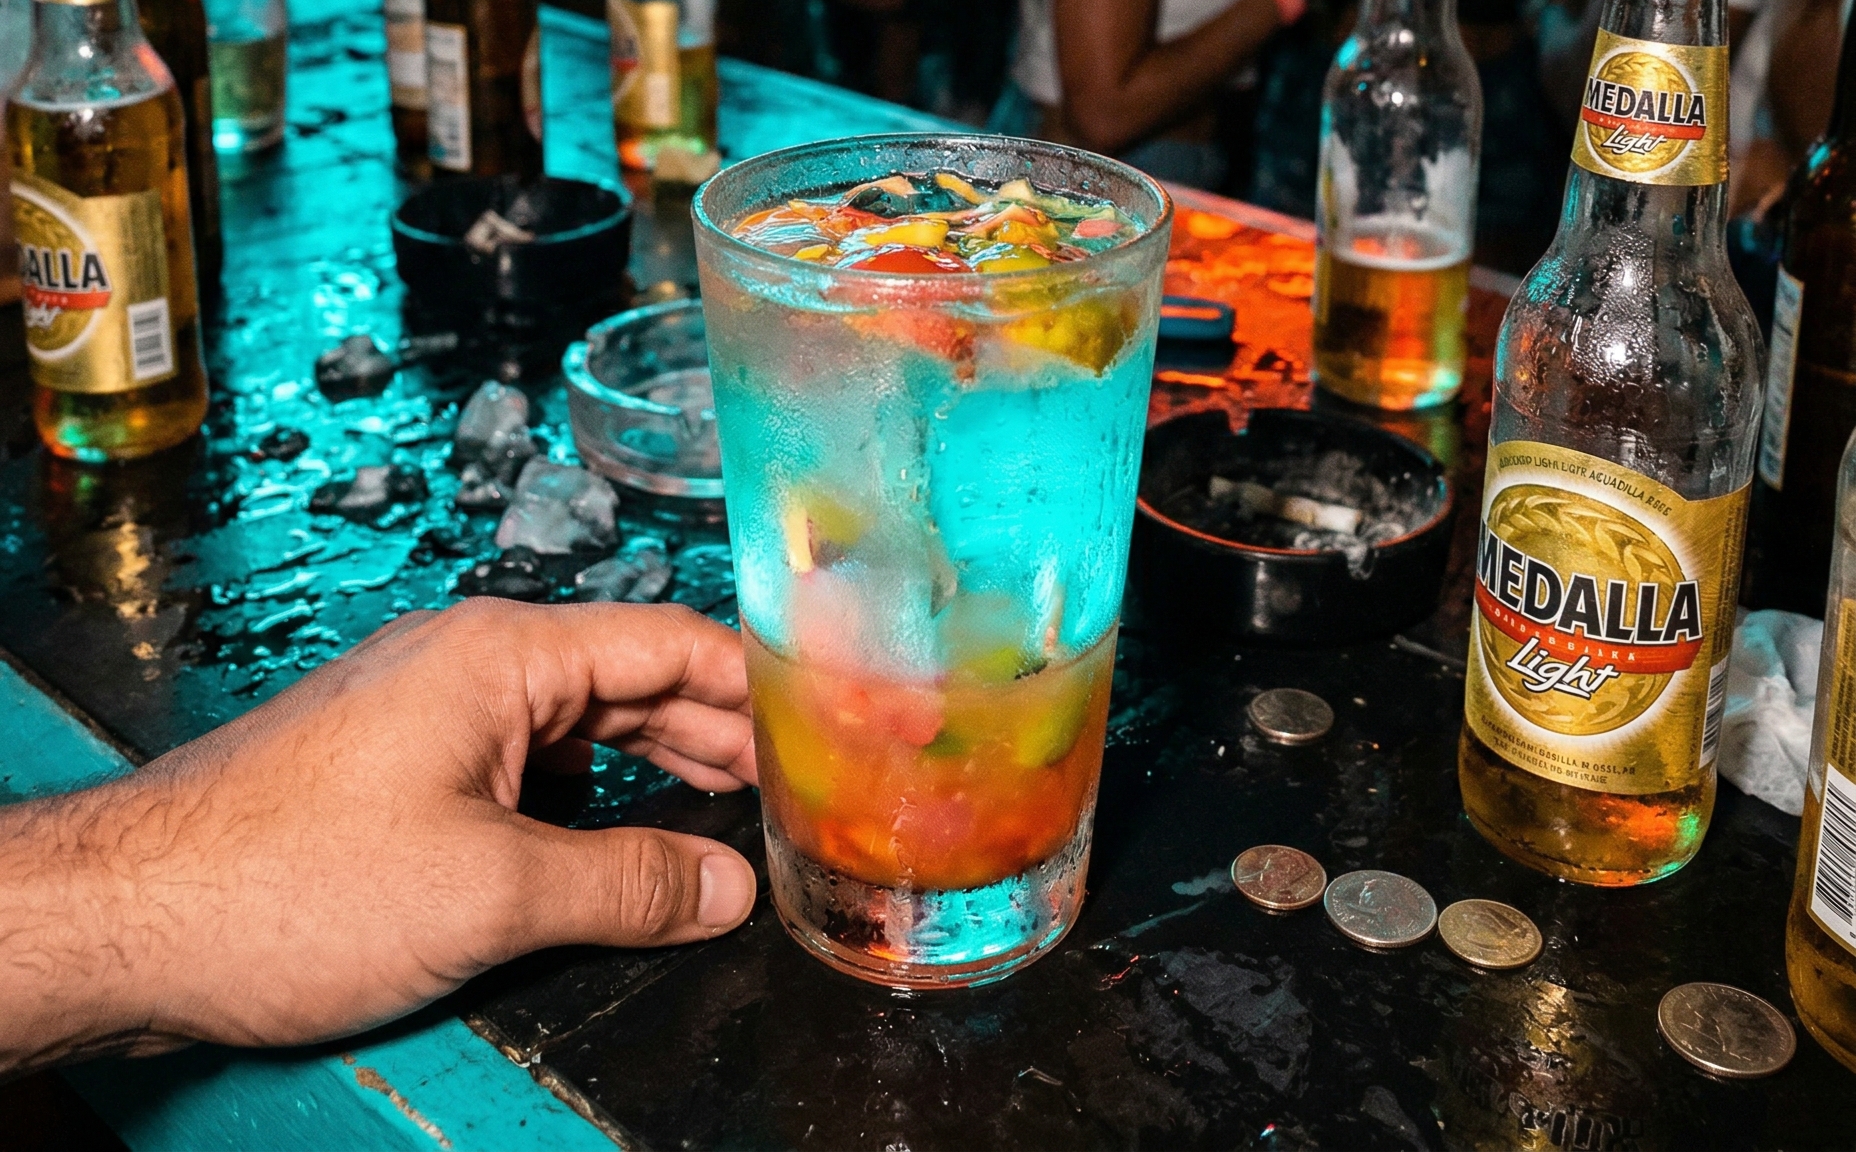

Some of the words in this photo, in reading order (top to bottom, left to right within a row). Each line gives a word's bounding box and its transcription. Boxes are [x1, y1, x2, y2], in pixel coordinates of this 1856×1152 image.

[1583, 77, 1707, 127] MEDALLA
[1601, 124, 1667, 155] Light
[20, 243, 112, 294] ALLA
[1476, 519, 1703, 645] MEDALLA
[1506, 637, 1620, 700] Light
